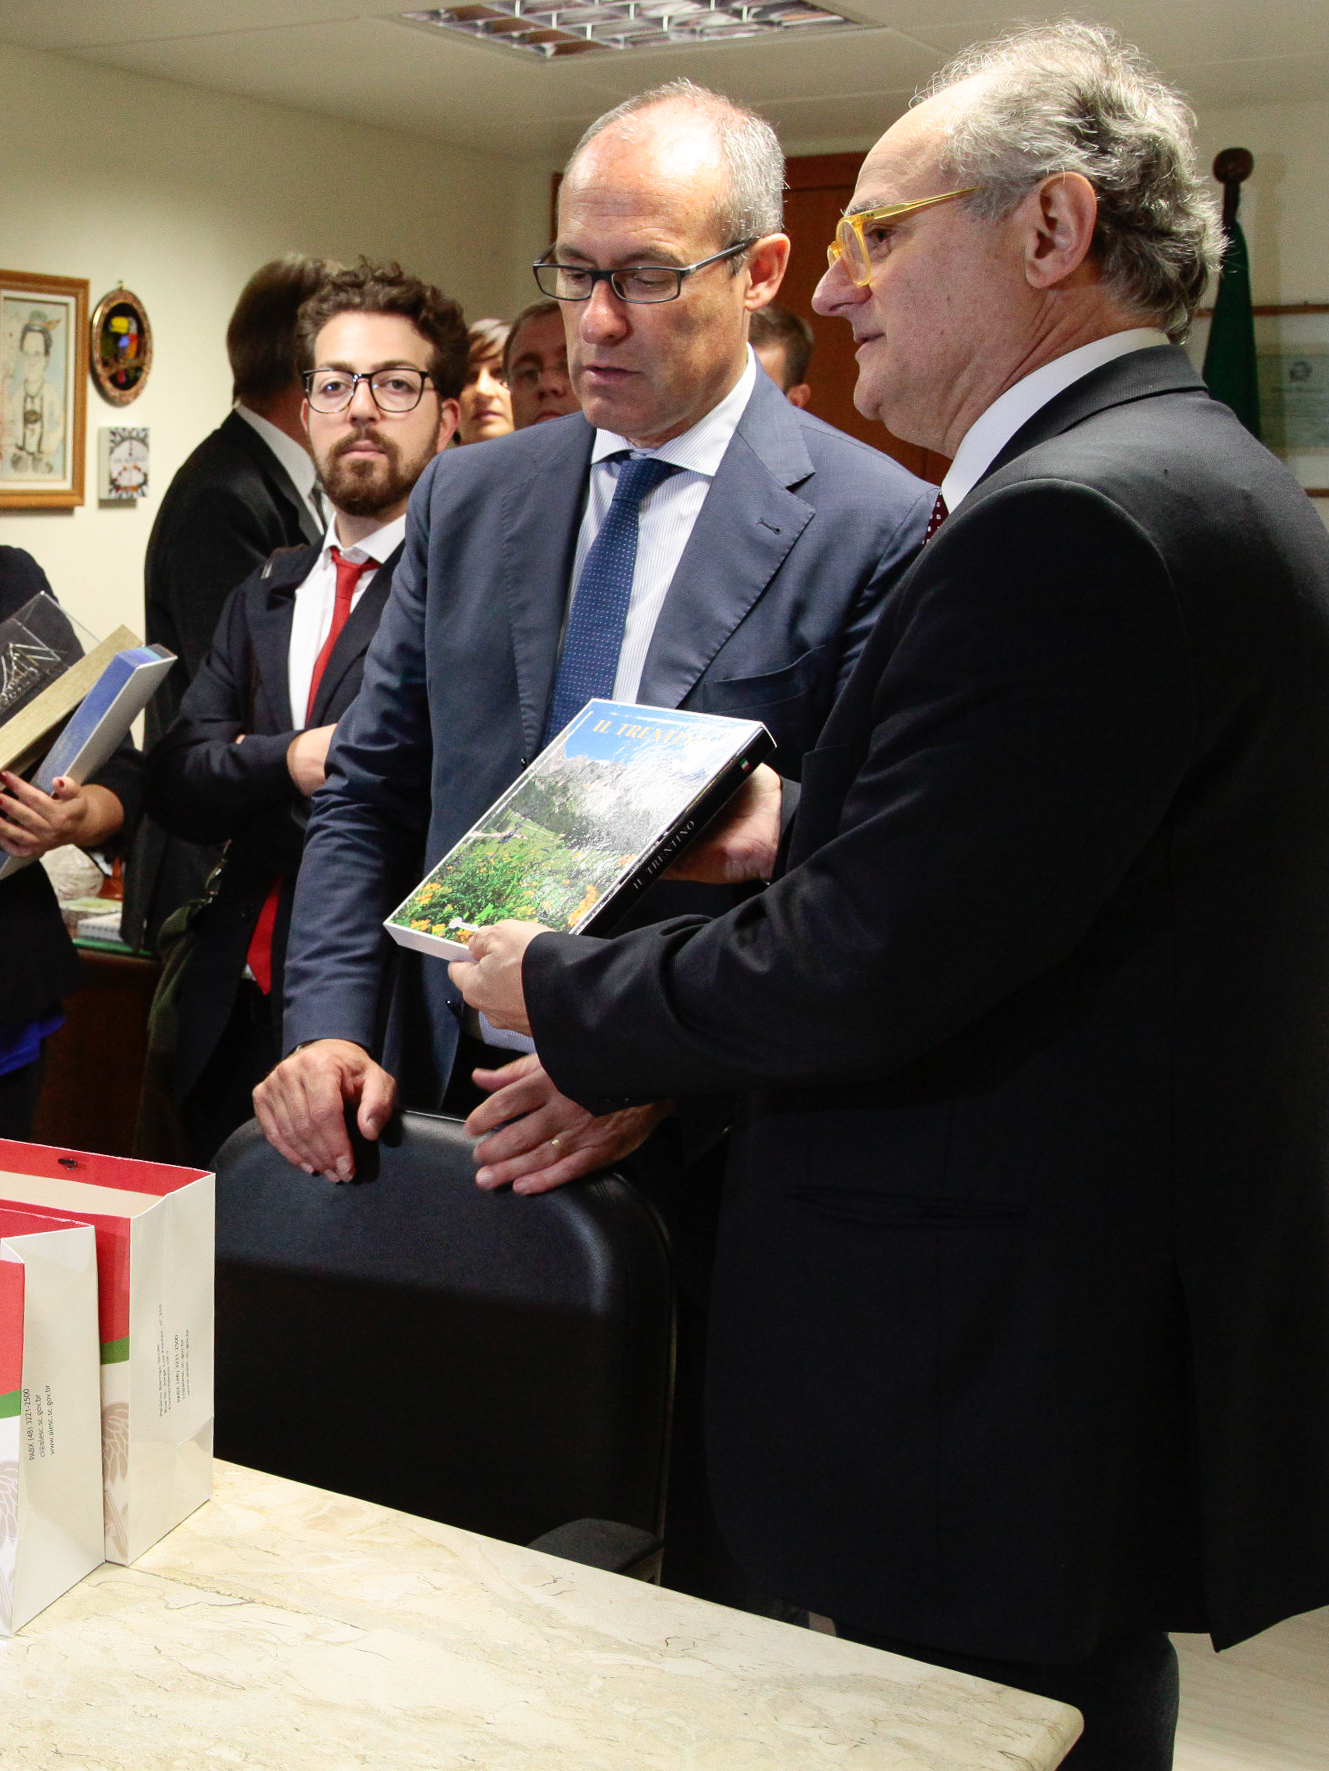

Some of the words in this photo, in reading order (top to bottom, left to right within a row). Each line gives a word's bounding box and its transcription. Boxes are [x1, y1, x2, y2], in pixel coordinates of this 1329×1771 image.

[592, 719, 612, 733] IL
[633, 878, 643, 889] IL
[646, 820, 694, 874] TRENTINO
[23, 1388, 33, 1425] 3221-2500
[26, 1426, 34, 1441] (48)
[28, 1443, 36, 1461] PABX
